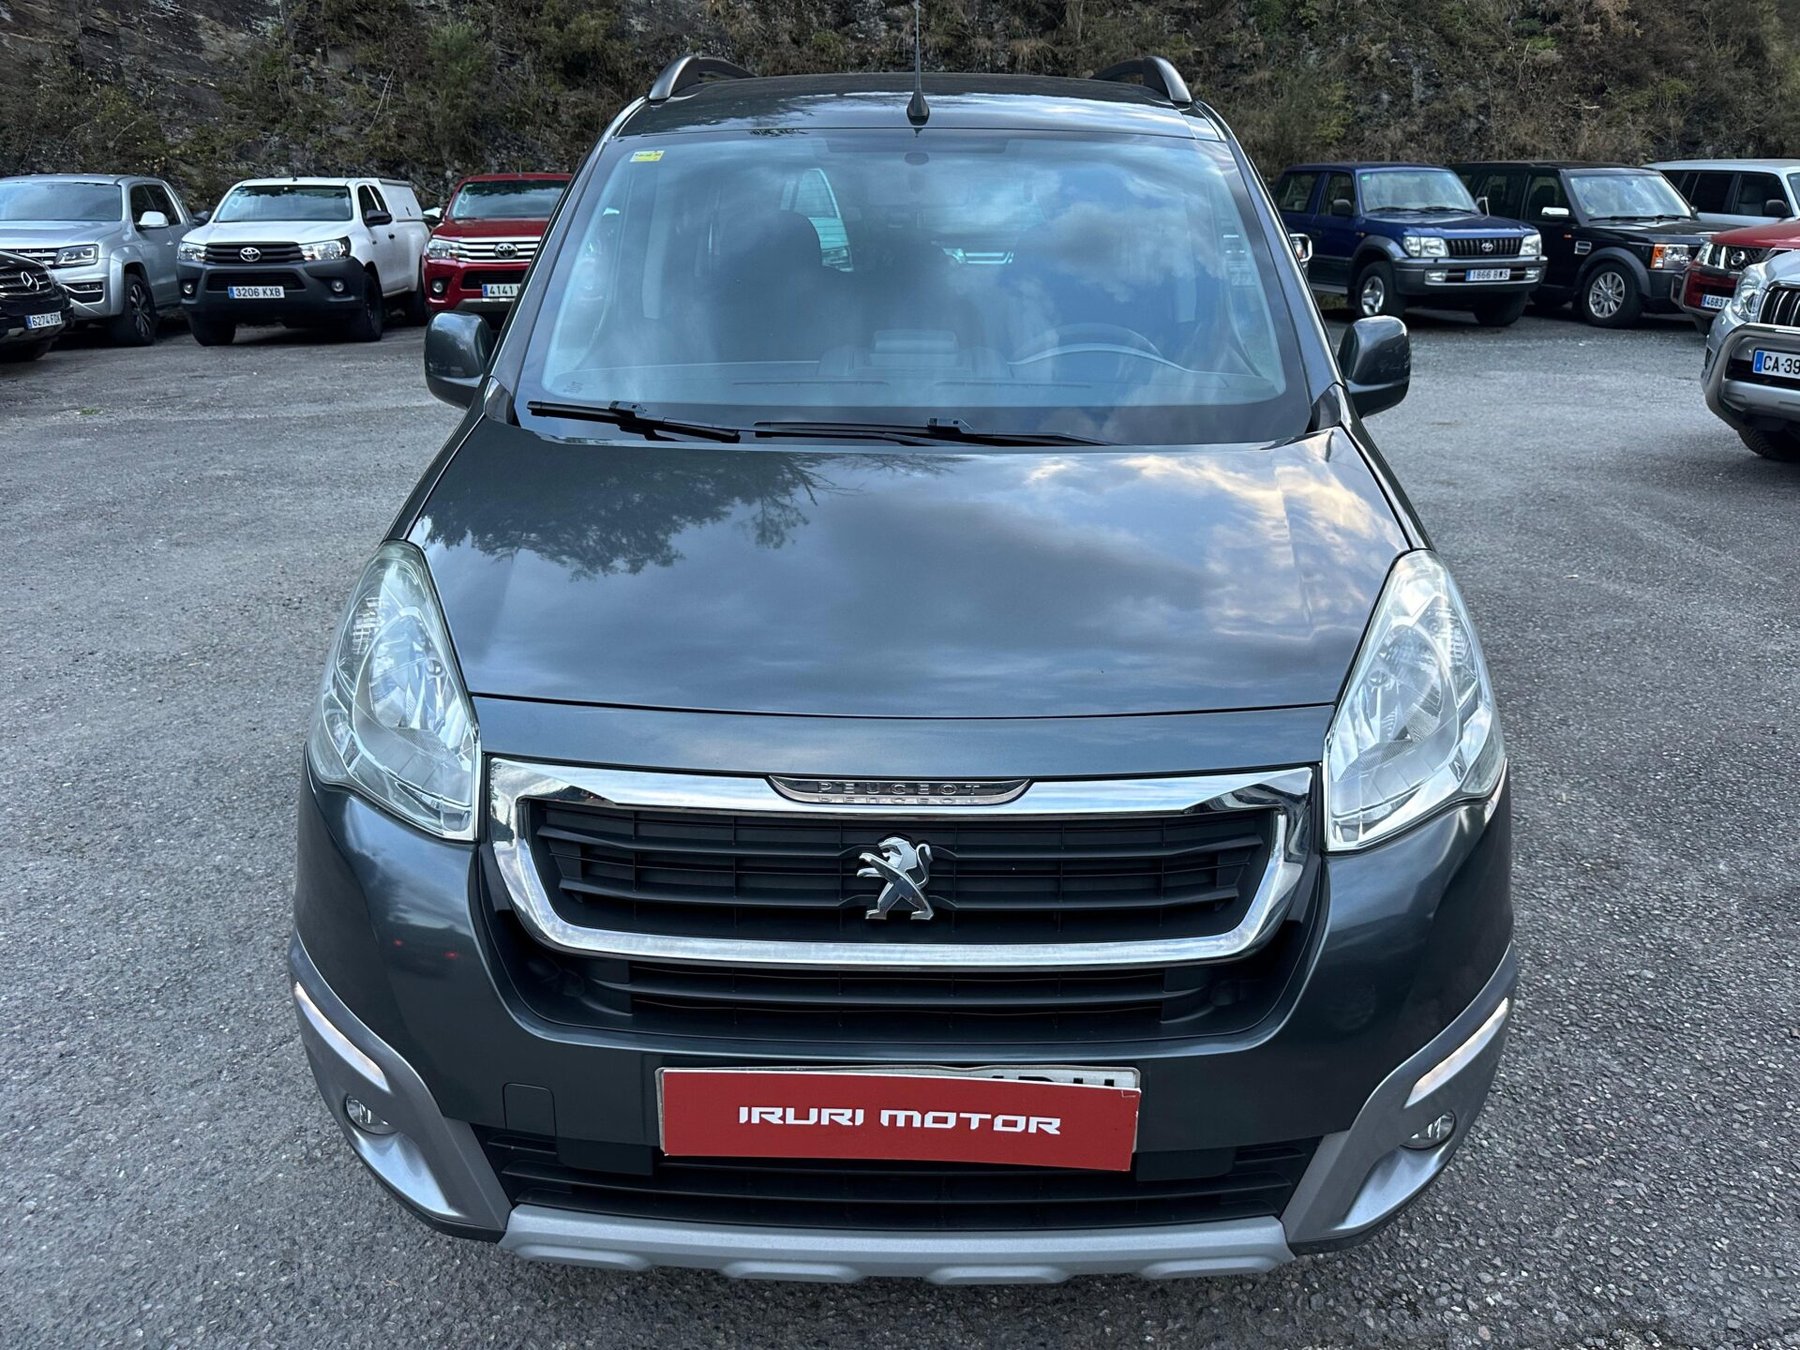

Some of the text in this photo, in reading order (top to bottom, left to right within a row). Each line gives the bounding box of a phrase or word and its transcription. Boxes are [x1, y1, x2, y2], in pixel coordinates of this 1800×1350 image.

[235, 287, 281, 297] 3206 KXB
[489, 285, 513, 295] 4141
[1706, 297, 1723, 307] 4683
[32, 315, 50, 326] 6274
[1763, 355, 1800, 375] CA-39
[818, 781, 980, 796] PEUGEOT
[738, 1106, 1061, 1135] IRURI MOTOR
